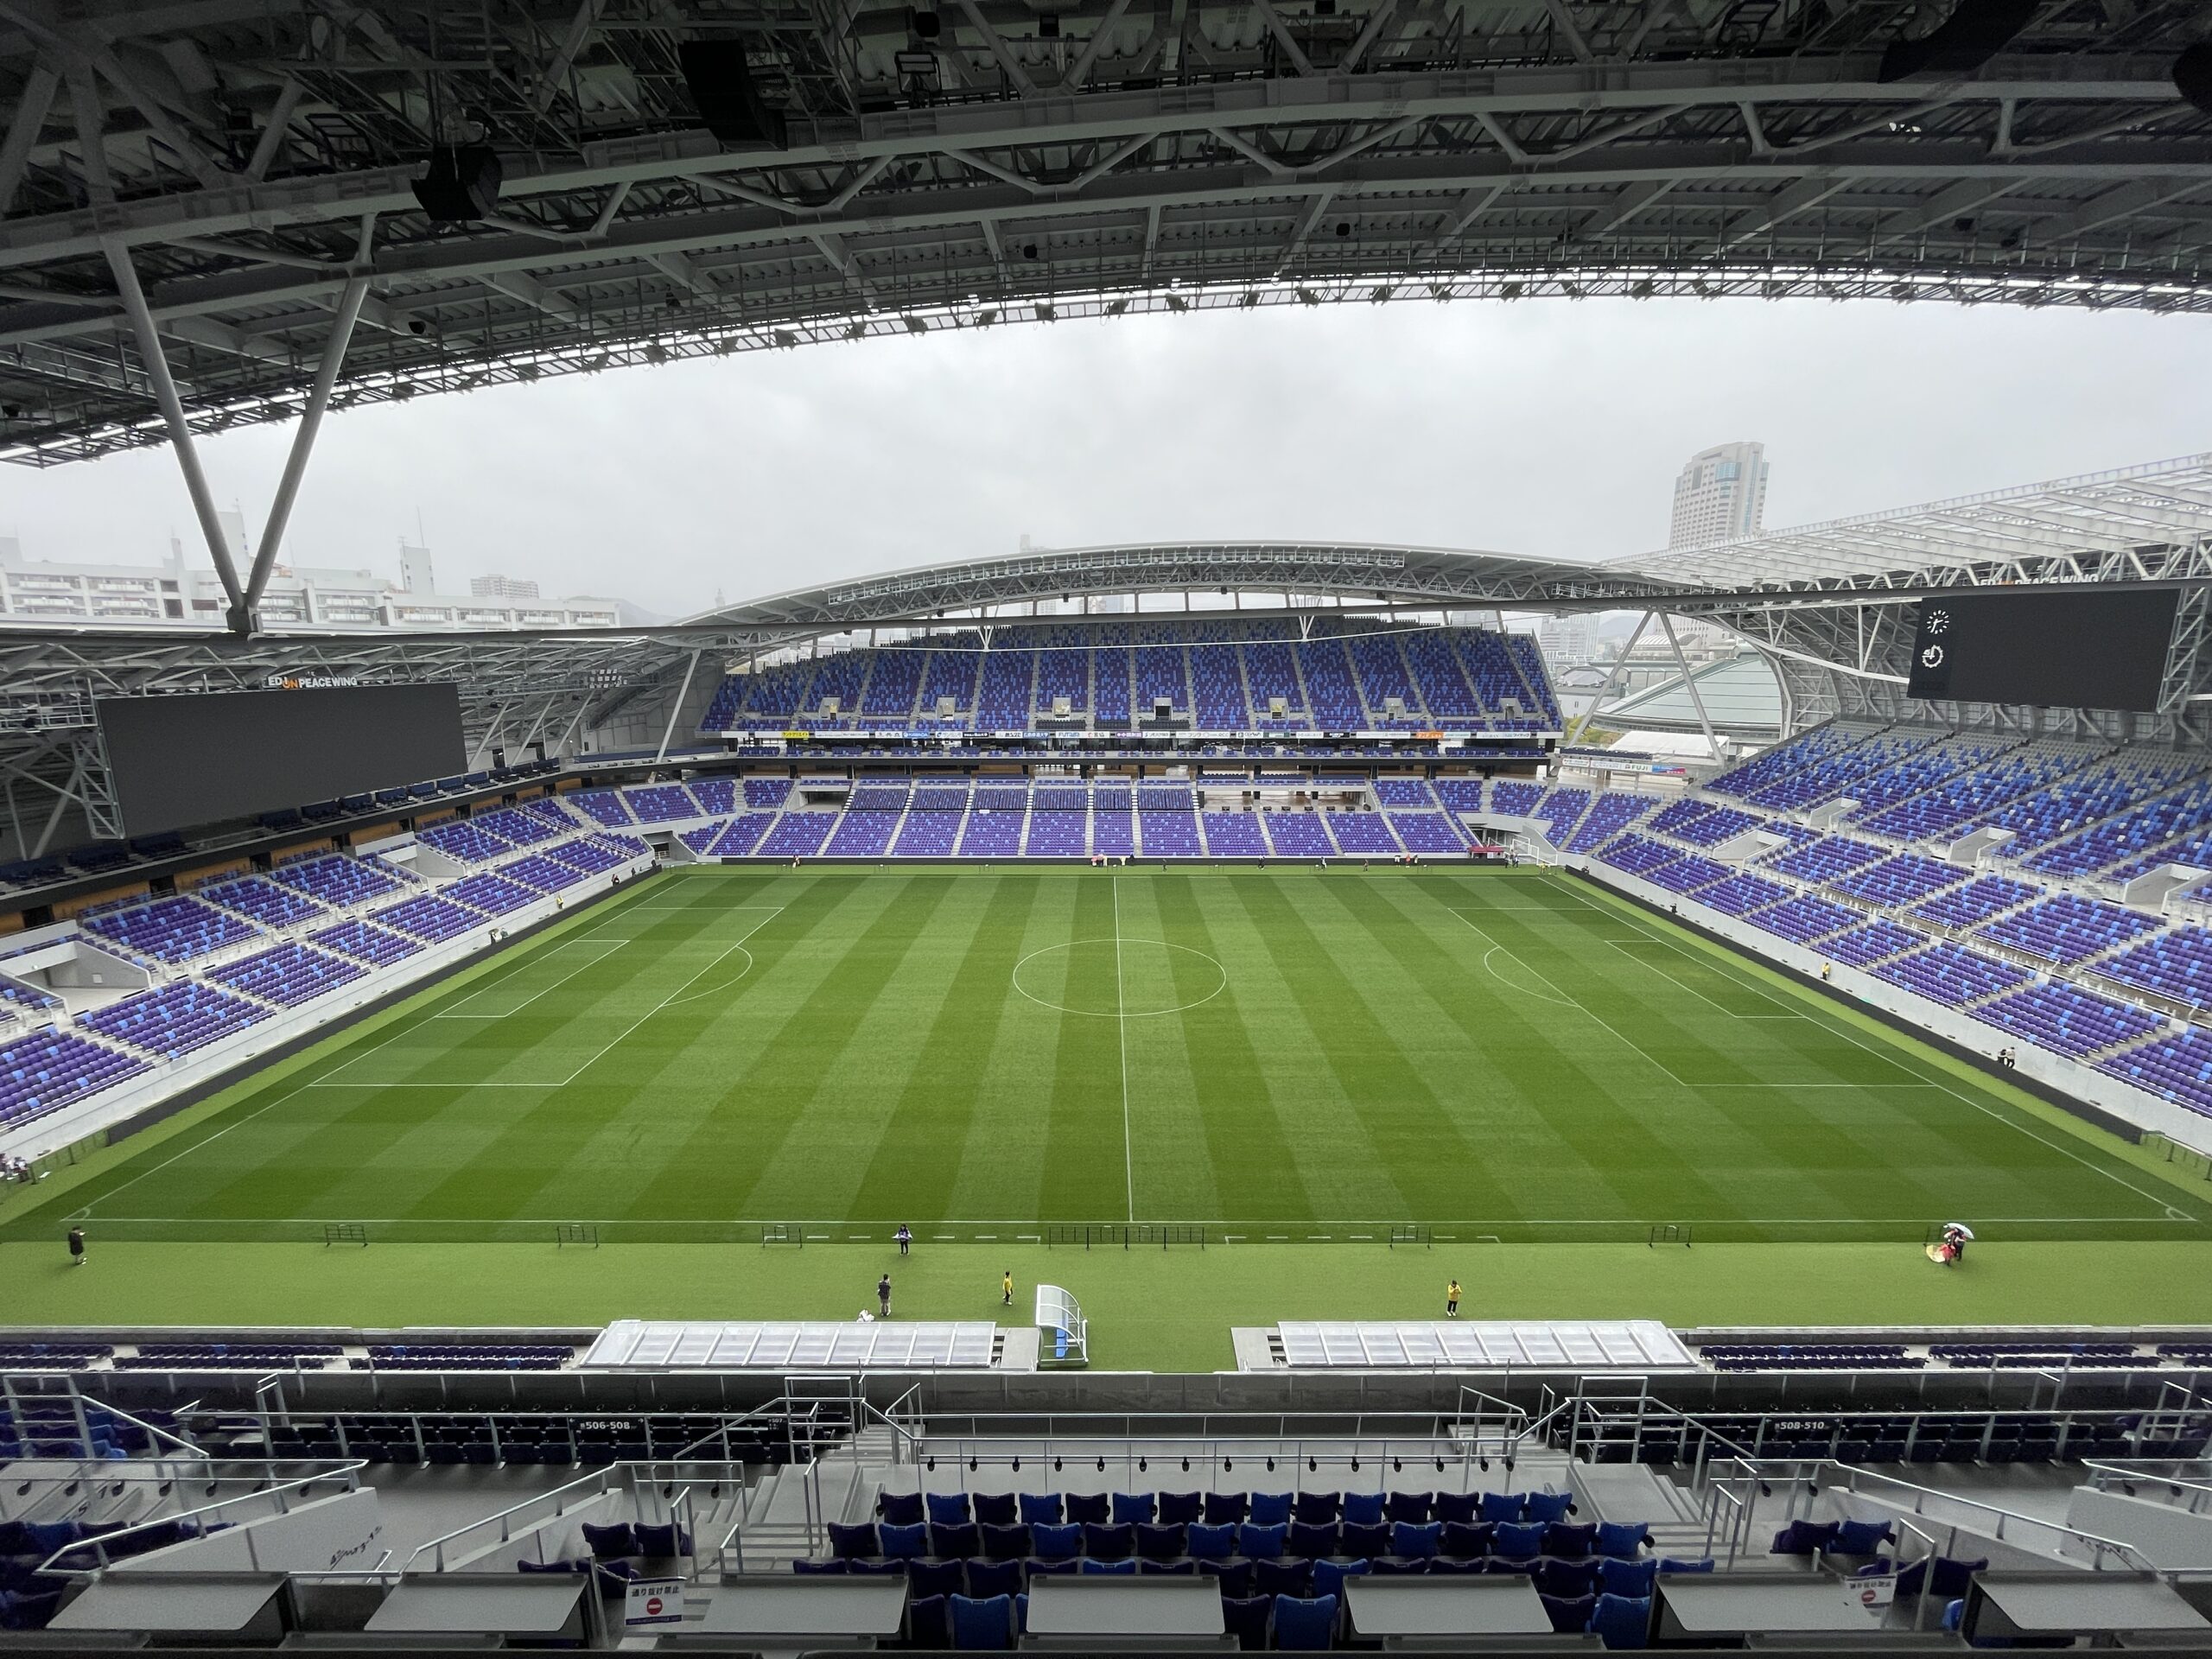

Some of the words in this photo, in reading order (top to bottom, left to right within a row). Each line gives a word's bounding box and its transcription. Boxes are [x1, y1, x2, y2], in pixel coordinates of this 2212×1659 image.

[268, 677, 299, 690] EDION
[299, 677, 332, 688] PEACE
[332, 677, 358, 687] WING
[585, 1421, 630, 1430] 506-508
[1780, 1421, 1825, 1430] 508-510
[632, 1586, 679, 1597] 通り抜け禁止
